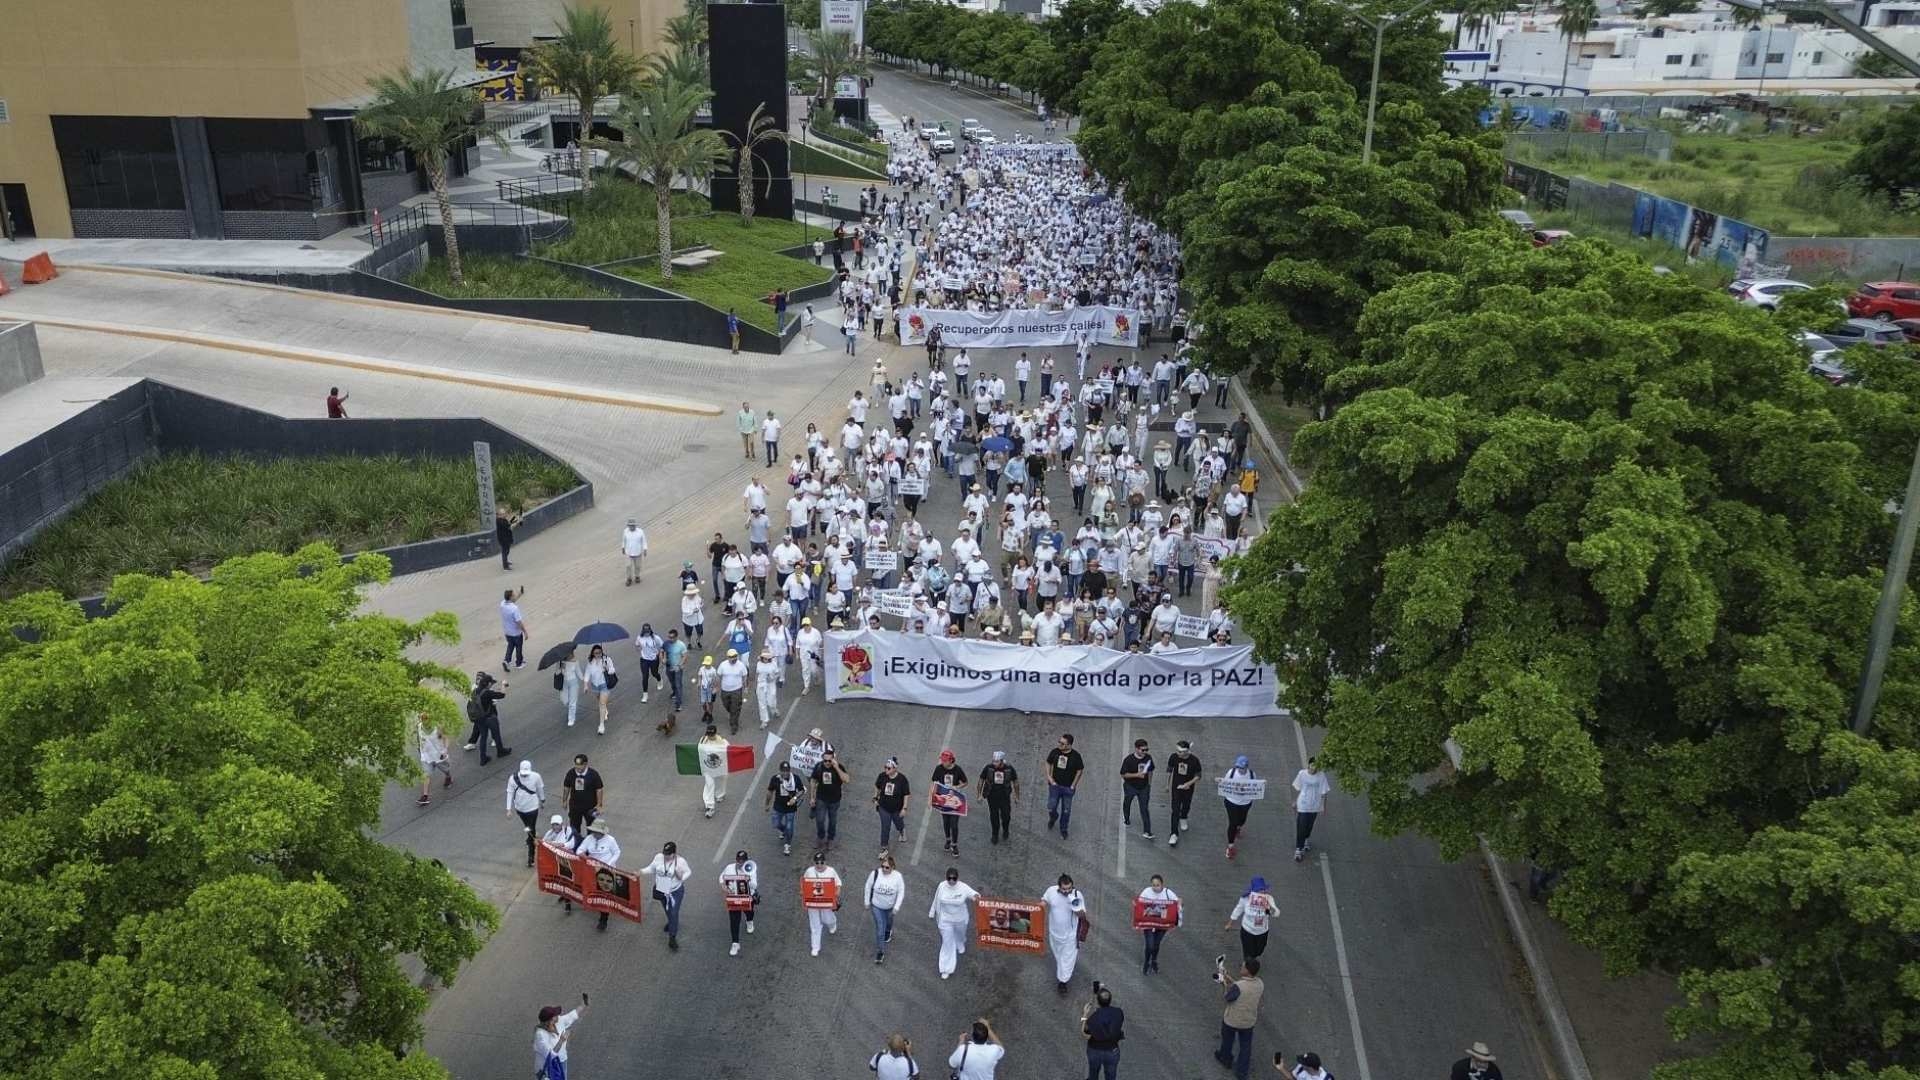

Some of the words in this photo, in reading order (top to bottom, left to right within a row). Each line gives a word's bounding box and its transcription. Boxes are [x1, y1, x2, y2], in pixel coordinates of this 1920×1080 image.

[1018, 323, 1067, 334] nuestras
[884, 656, 992, 681] ¡Exigimos
[1000, 669, 1041, 684] una
[1048, 668, 1130, 690] agenda
[1138, 674, 1177, 691] por
[1184, 670, 1202, 687] la
[1211, 667, 1263, 687] PAZ!
[978, 900, 1041, 912] DESAPARECIDO
